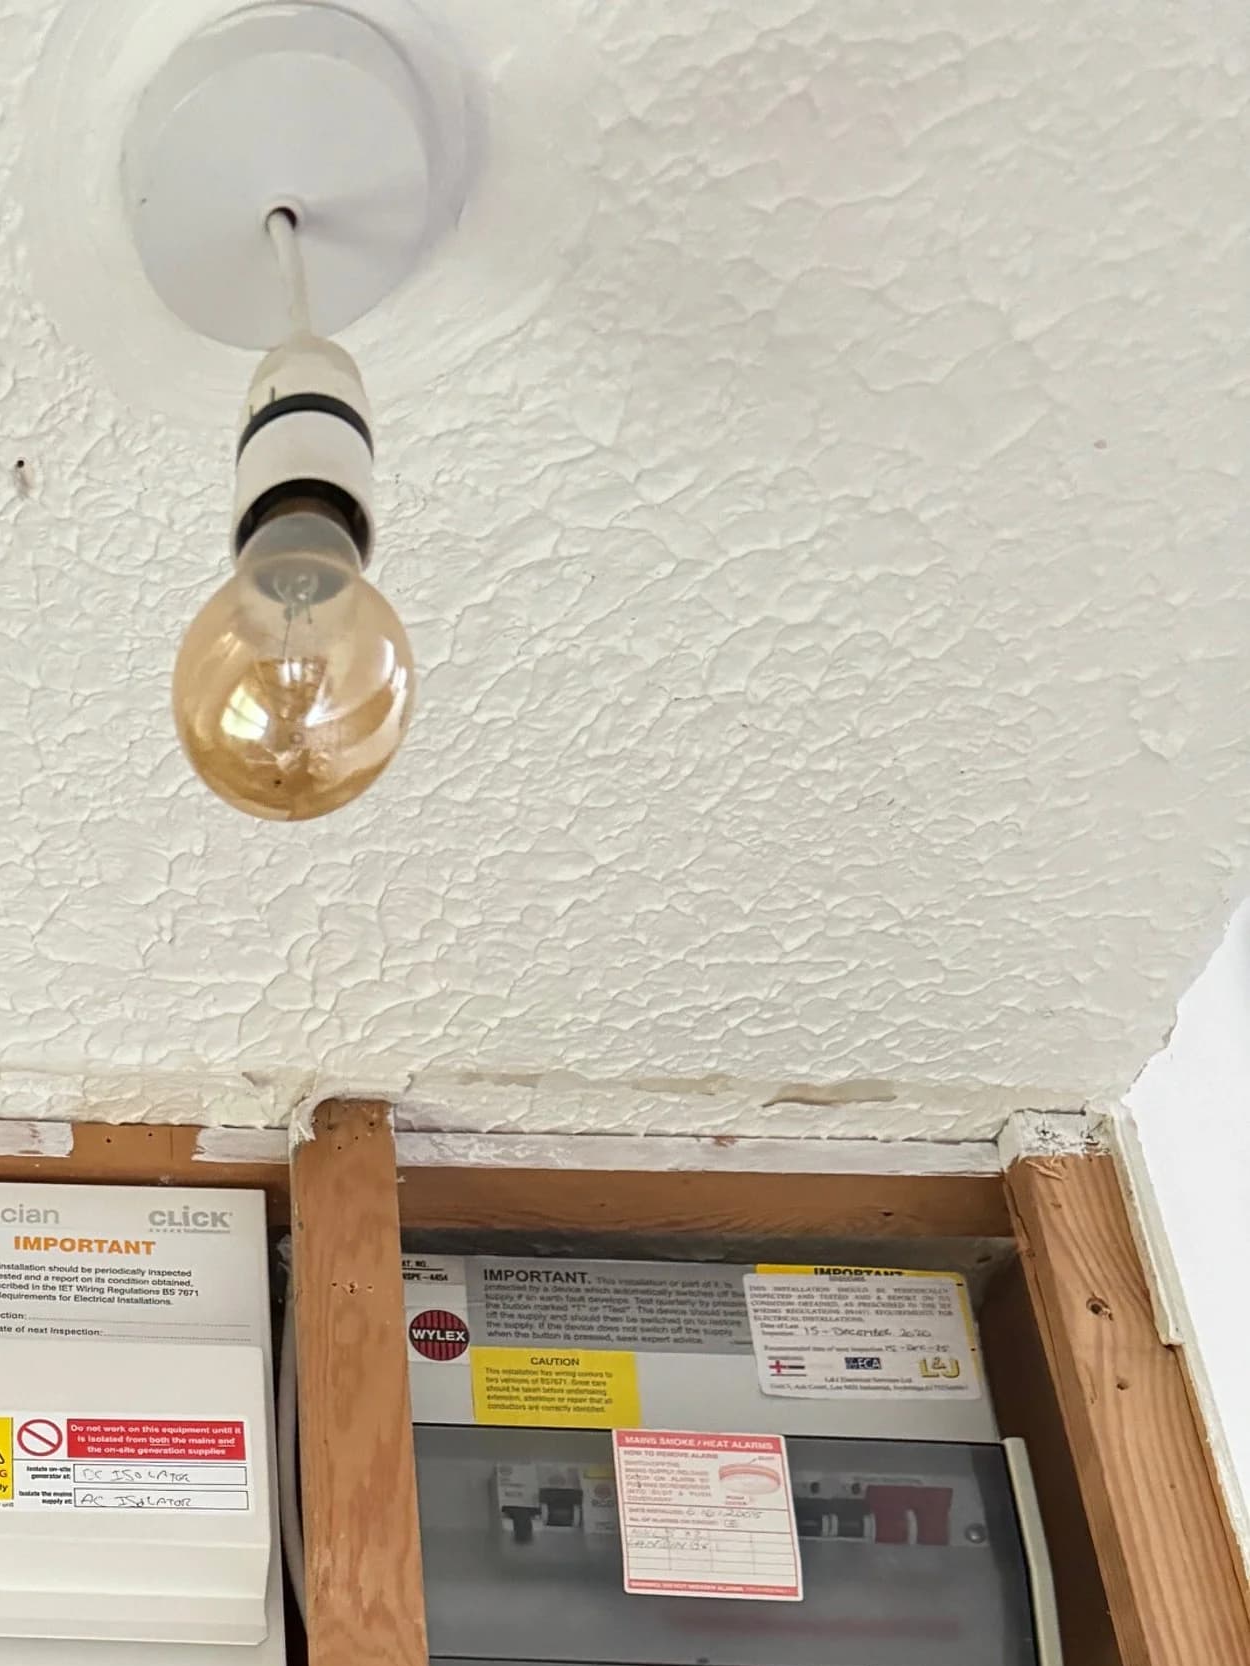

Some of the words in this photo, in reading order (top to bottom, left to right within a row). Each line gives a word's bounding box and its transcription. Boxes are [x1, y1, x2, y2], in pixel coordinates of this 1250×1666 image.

[13, 1235, 156, 1256] IMPORTANT
[49, 1265, 78, 1273] should
[95, 1268, 145, 1276] periodically
[149, 1269, 191, 1277] inspected
[483, 1269, 592, 1284] IMPORTANT.
[76, 1285, 104, 1294] Wiring
[107, 1287, 160, 1295] Regulations
[163, 1288, 175, 1296] BS
[75, 1295, 115, 1303] Electrical
[15, 1325, 25, 1333] of
[28, 1326, 47, 1334] next
[412, 1328, 466, 1342] WYLEX
[531, 1357, 579, 1366] CAUTION
[104, 1425, 125, 1433] work
[162, 1426, 210, 1435] equipment
[659, 1437, 695, 1447] SMOKE
[703, 1439, 728, 1448] HEAT
[104, 1446, 135, 1454] on-site
[138, 1447, 185, 1455] generation
[188, 1448, 226, 1456] supplies
